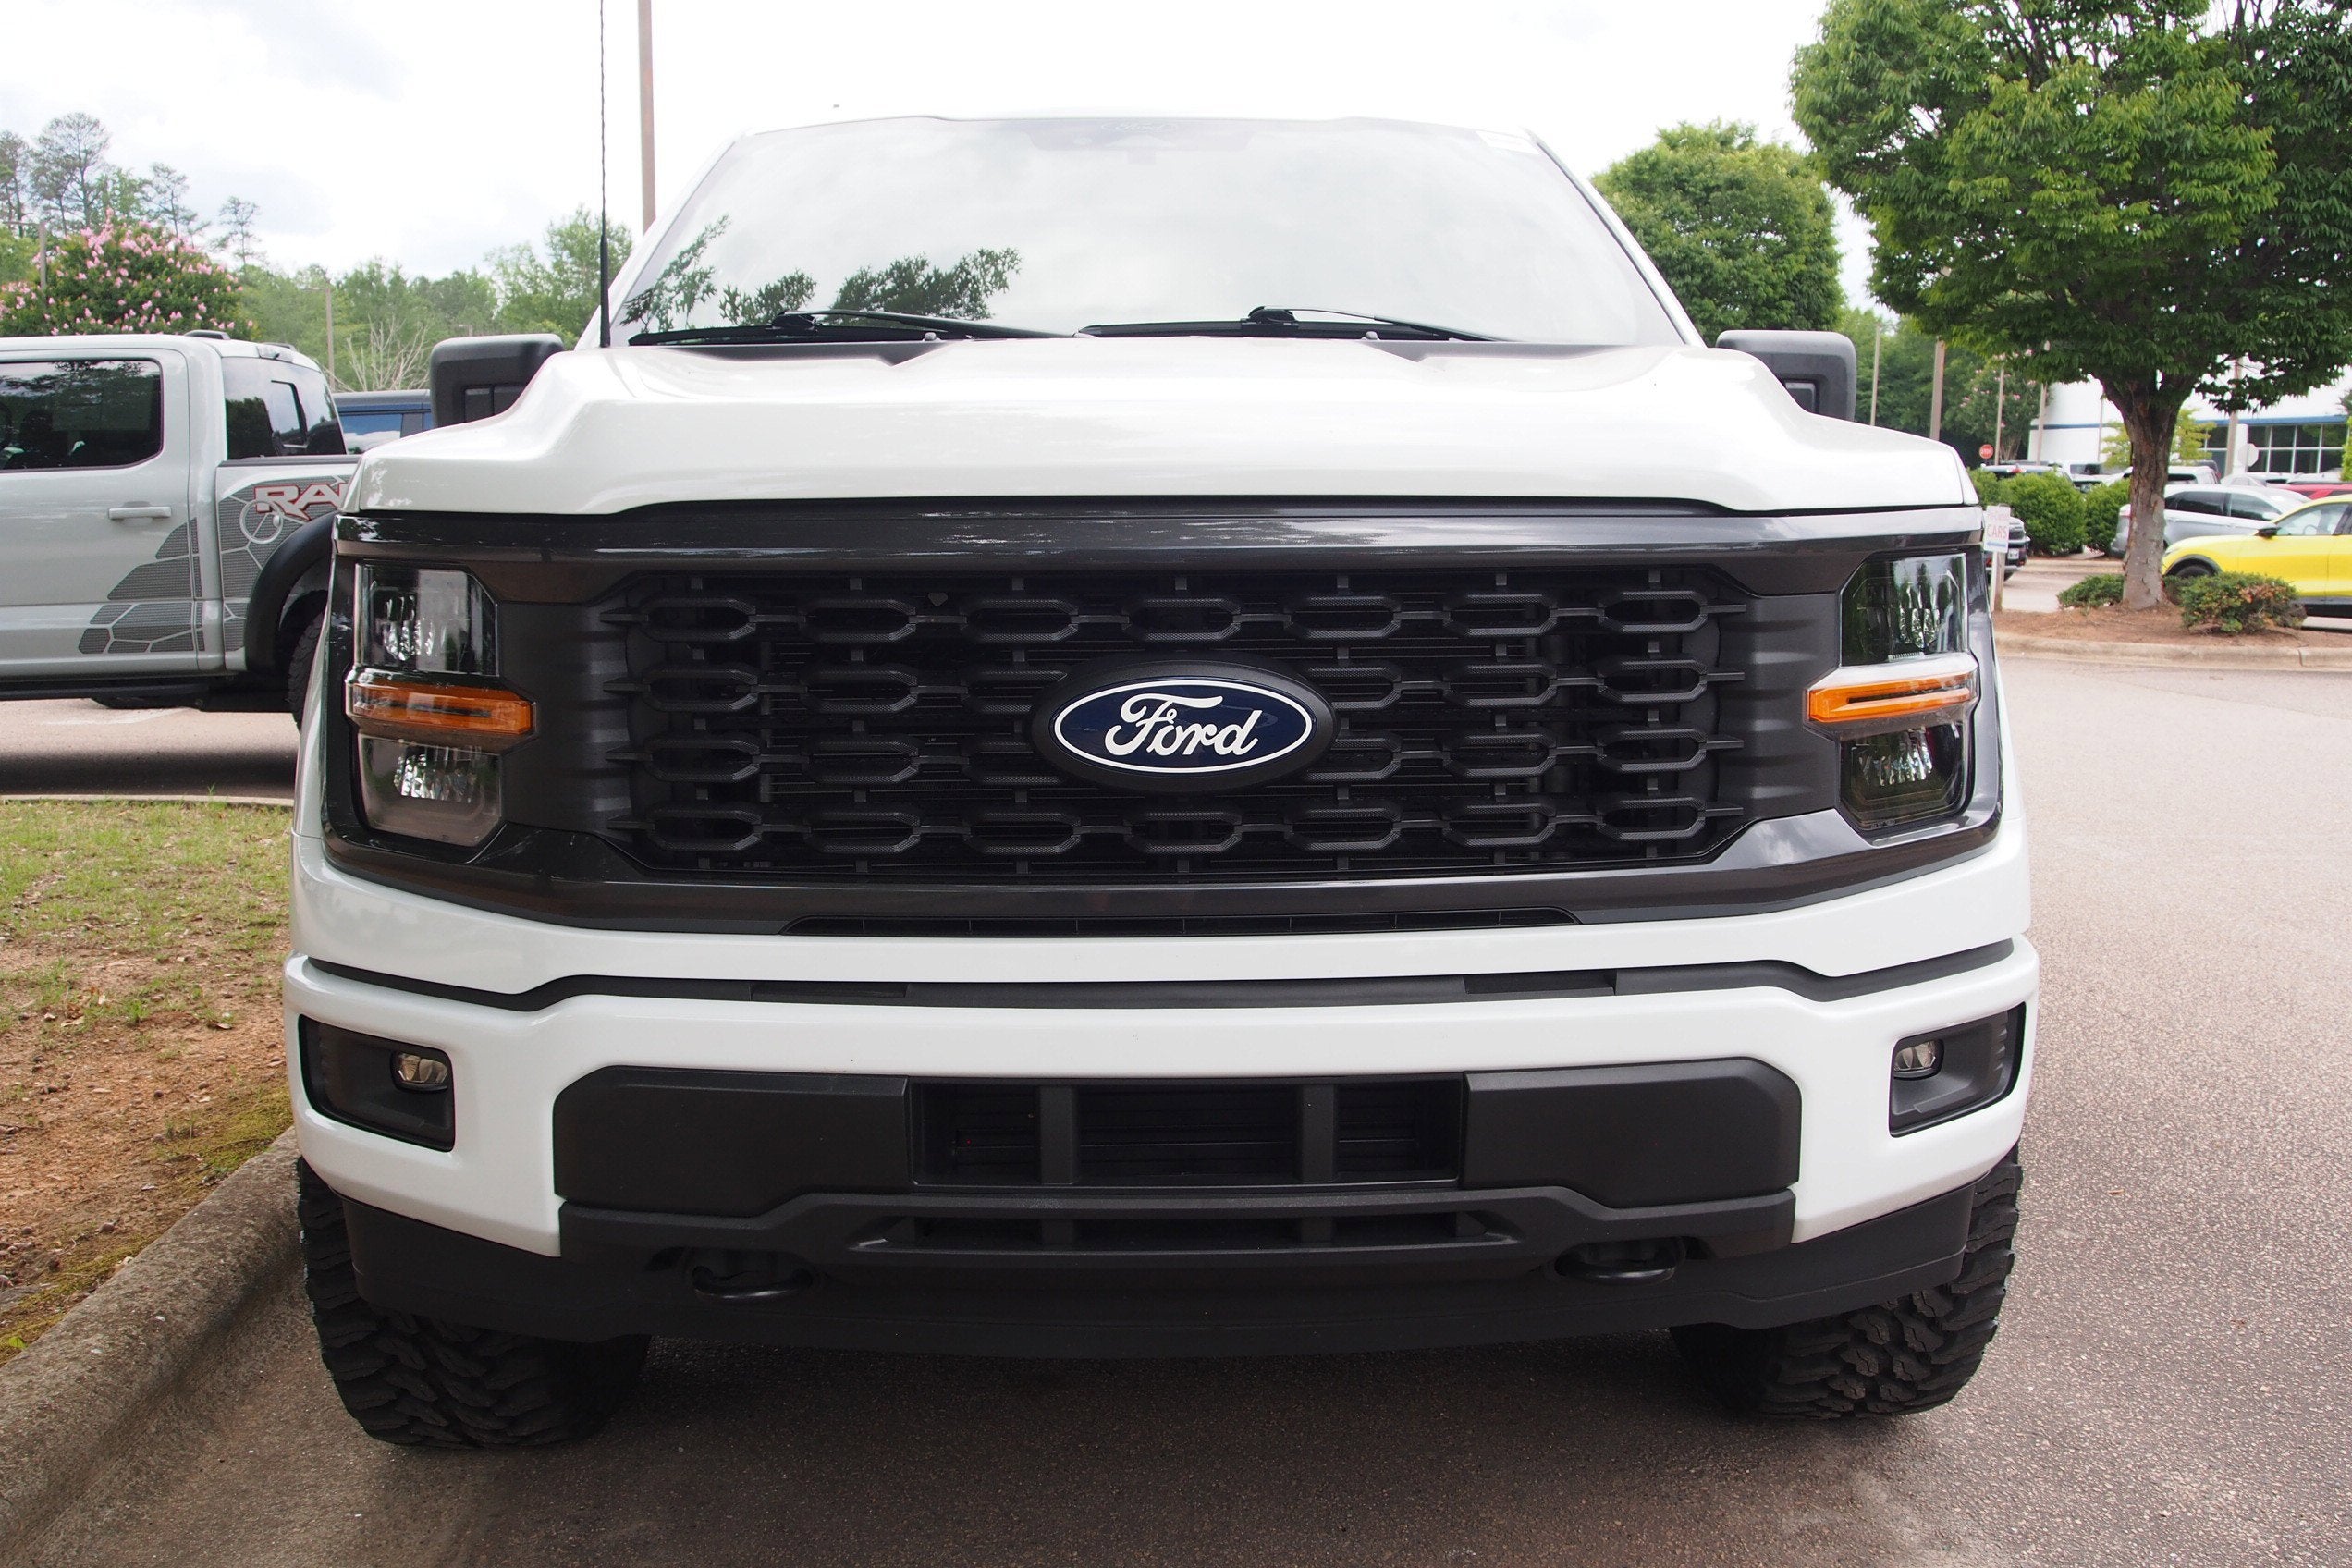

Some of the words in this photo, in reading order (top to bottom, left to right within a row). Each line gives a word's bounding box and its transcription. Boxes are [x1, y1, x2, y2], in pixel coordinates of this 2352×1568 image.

[254, 483, 349, 521] RA
[1986, 523, 2007, 539] CARS
[1105, 693, 1263, 756] Ford
